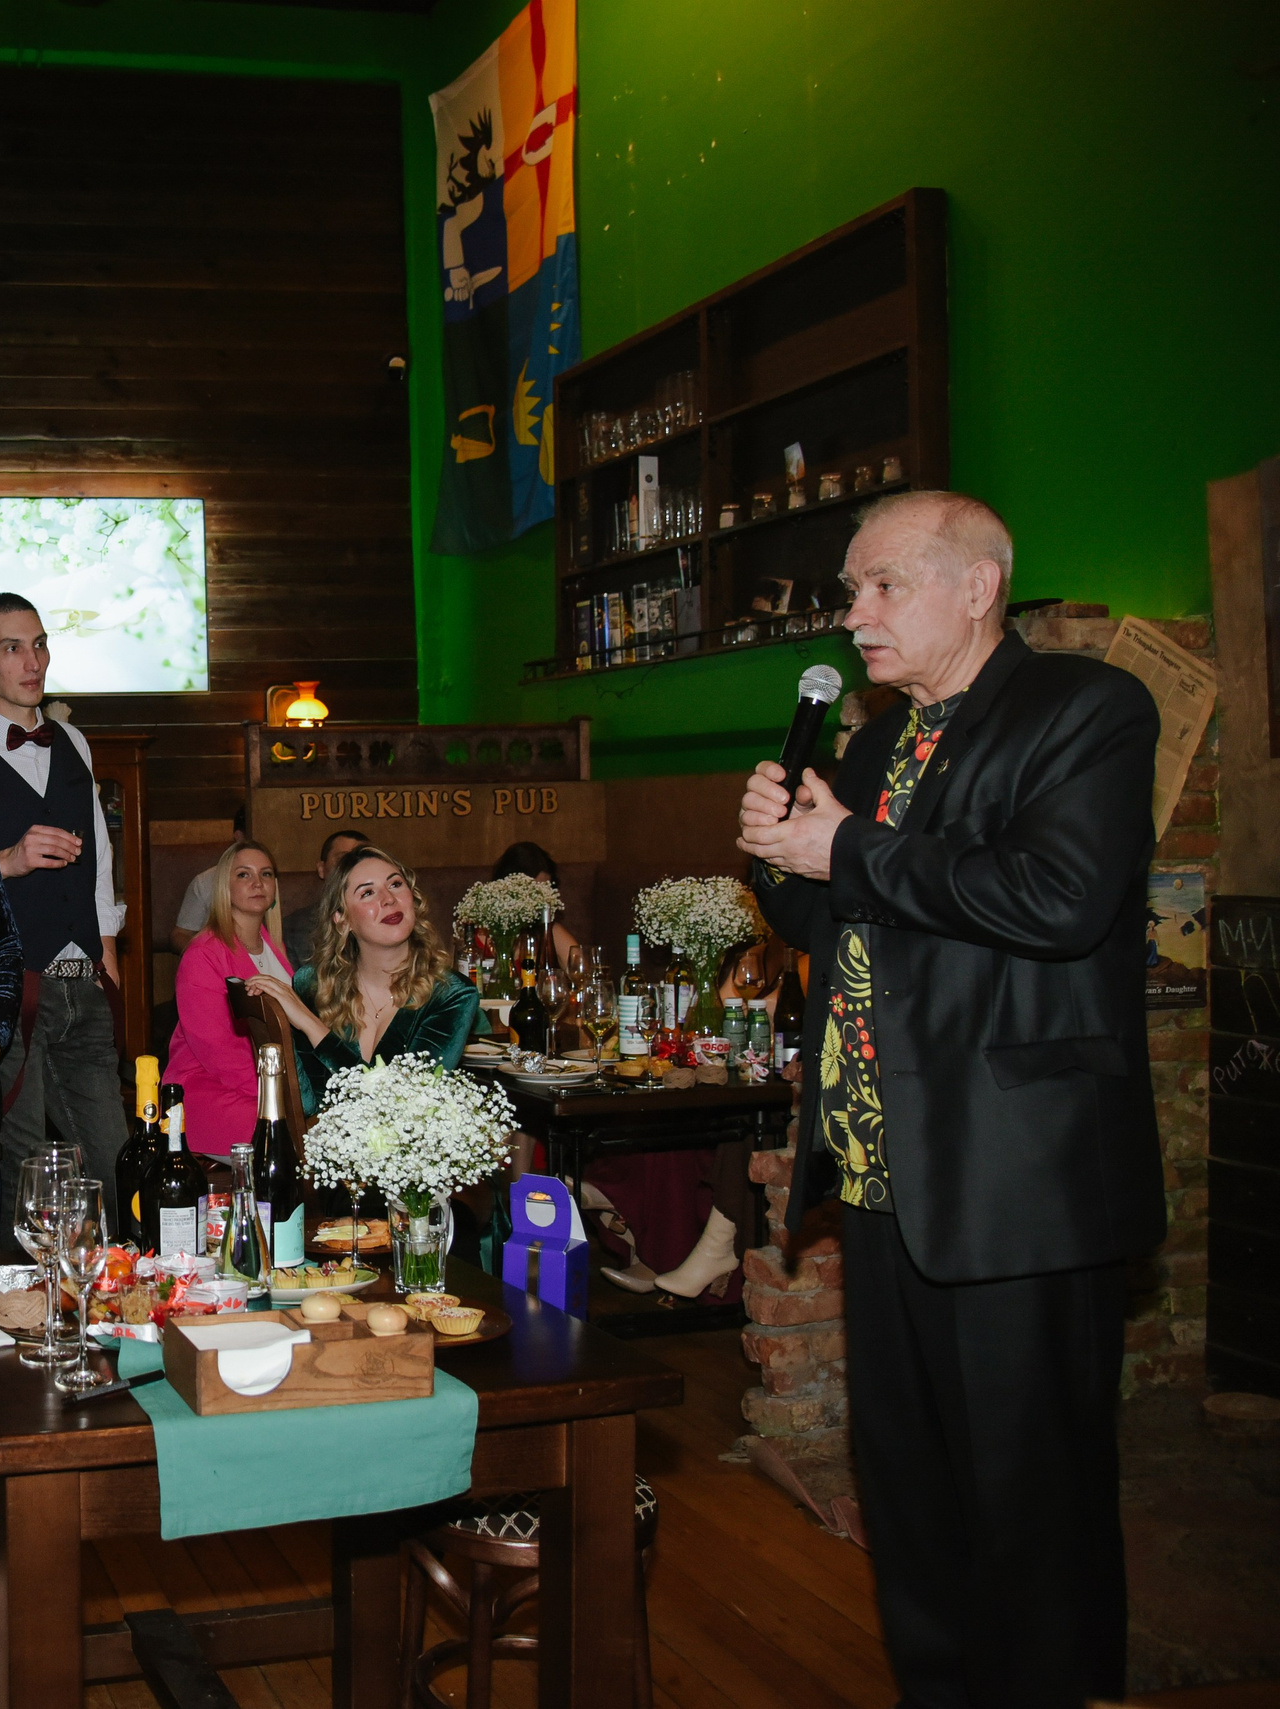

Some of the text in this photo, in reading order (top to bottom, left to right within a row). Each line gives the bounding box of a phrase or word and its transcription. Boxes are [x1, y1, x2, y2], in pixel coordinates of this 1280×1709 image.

[300, 787, 559, 821] PURKIN'S PUB
[1165, 985, 1197, 995] Daughter
